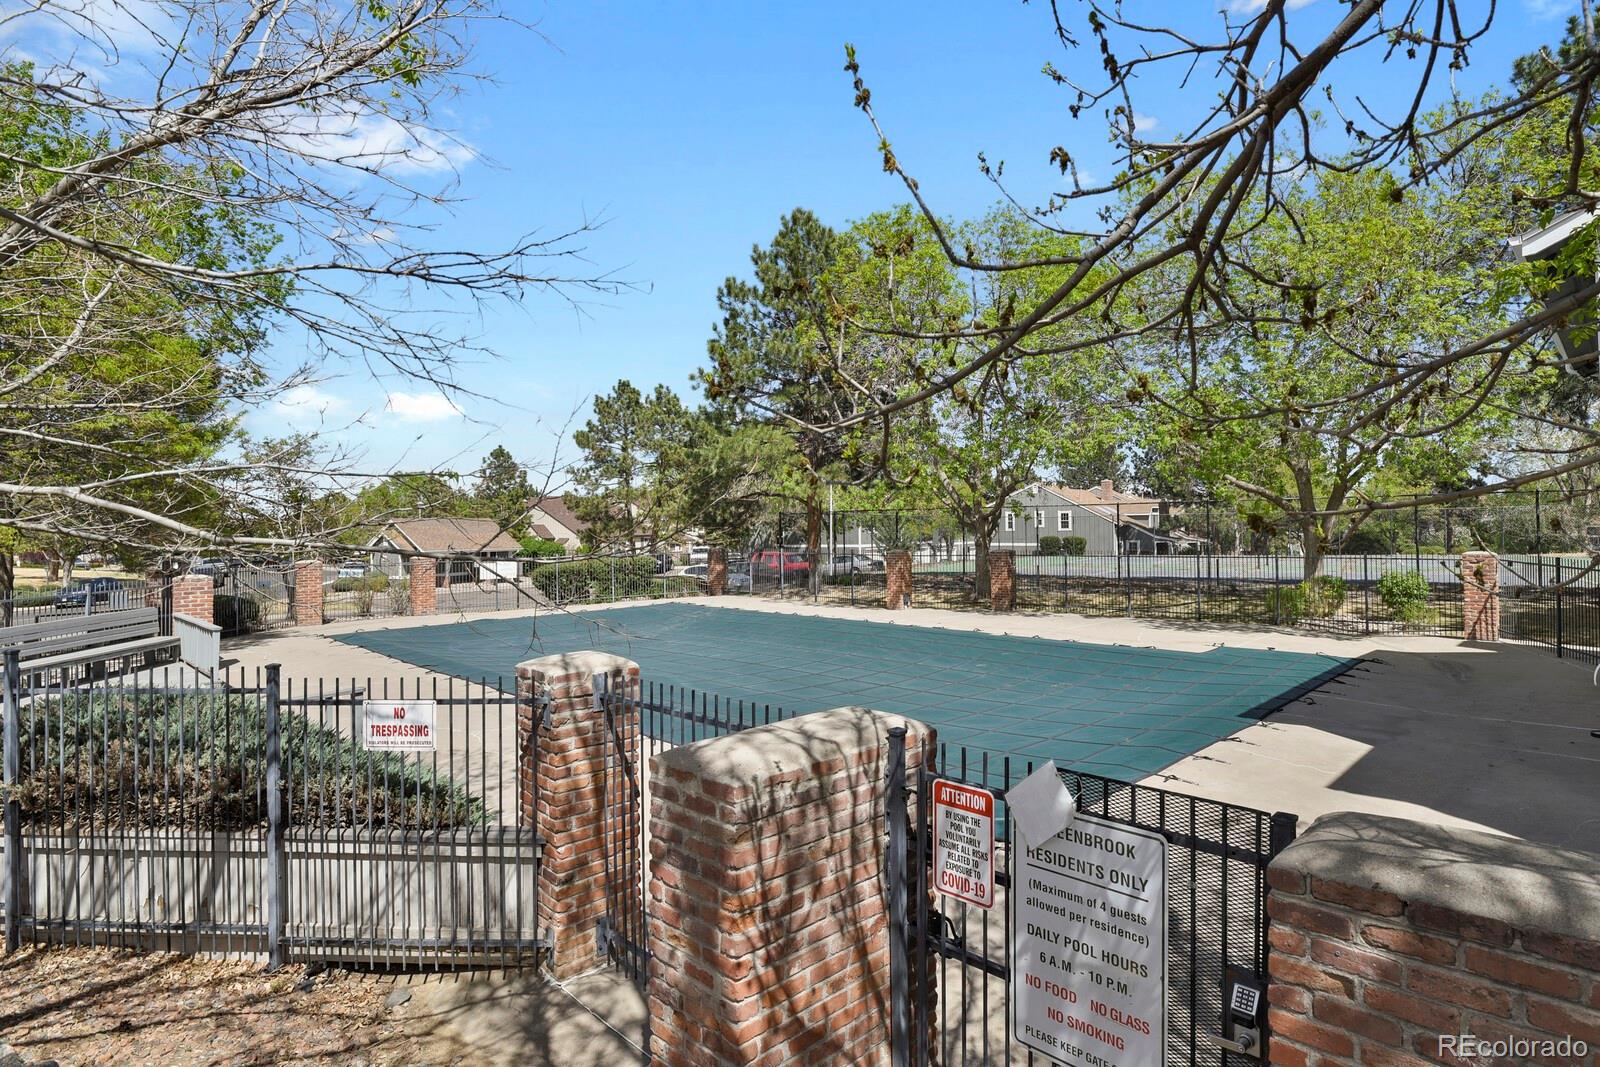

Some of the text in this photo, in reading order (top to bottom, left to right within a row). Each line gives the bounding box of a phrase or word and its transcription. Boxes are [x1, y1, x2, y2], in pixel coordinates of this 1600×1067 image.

[393, 707, 406, 720] NO
[371, 725, 429, 737] TRESPASSING
[941, 787, 986, 811] ATTENTION
[945, 809, 981, 828] BY USING THE
[950, 821, 976, 836] POOL YOU
[939, 838, 988, 861] ASSUME ALL RISKS
[945, 830, 981, 849] VOLUNTARILY
[1053, 827, 1136, 860] EENBROOK
[945, 861, 981, 880] EXPOSURE TO
[947, 851, 979, 869] RELATED TO
[1026, 845, 1148, 892] RESIDENTS ONLY
[941, 871, 985, 899] COVID-19
[1028, 878, 1147, 926] (Maximum of 4 guests
[1026, 897, 1149, 948] allowed per residence)
[1027, 923, 1148, 978] DAILY POOL HOURS
[1040, 951, 1046, 963] 6
[1049, 955, 1076, 975] A.M.
[1089, 971, 1102, 985] 10
[1106, 978, 1132, 998] P.M.
[1025, 973, 1150, 1035] NO FOOD NO GLASS
[1047, 1007, 1125, 1050] NO SMOKING
[1025, 1025, 1109, 1067] PLEASE KEEP GATE
